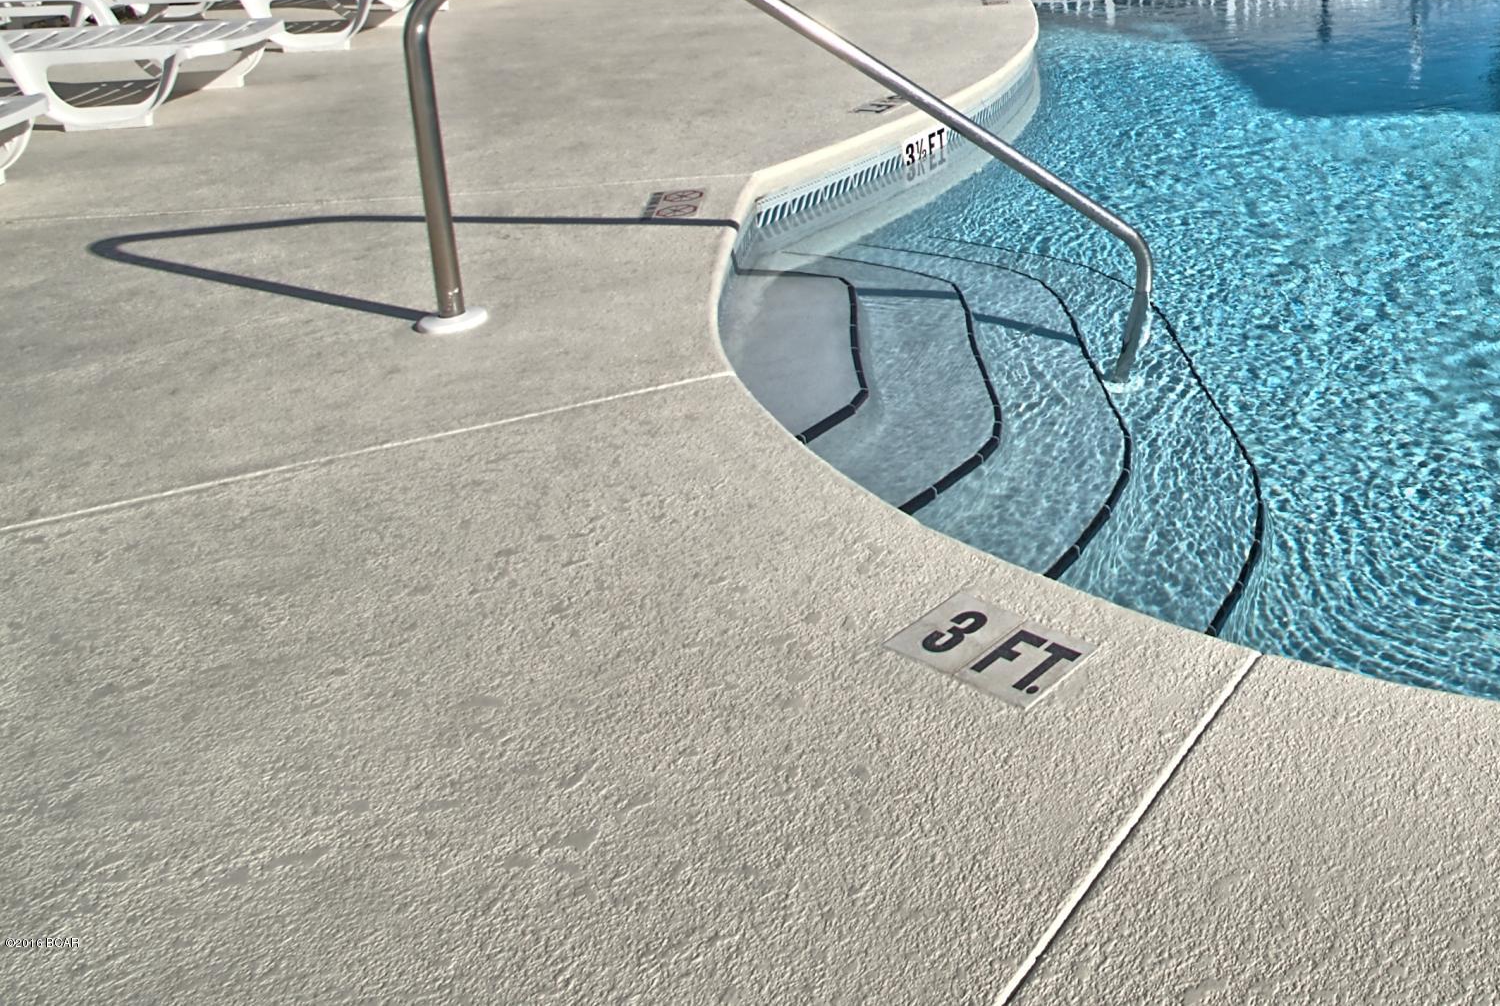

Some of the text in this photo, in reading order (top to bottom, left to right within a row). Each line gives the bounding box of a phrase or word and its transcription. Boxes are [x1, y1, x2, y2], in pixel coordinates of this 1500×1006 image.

[928, 128, 945, 156] FT
[921, 610, 1083, 694] 3 FT.
